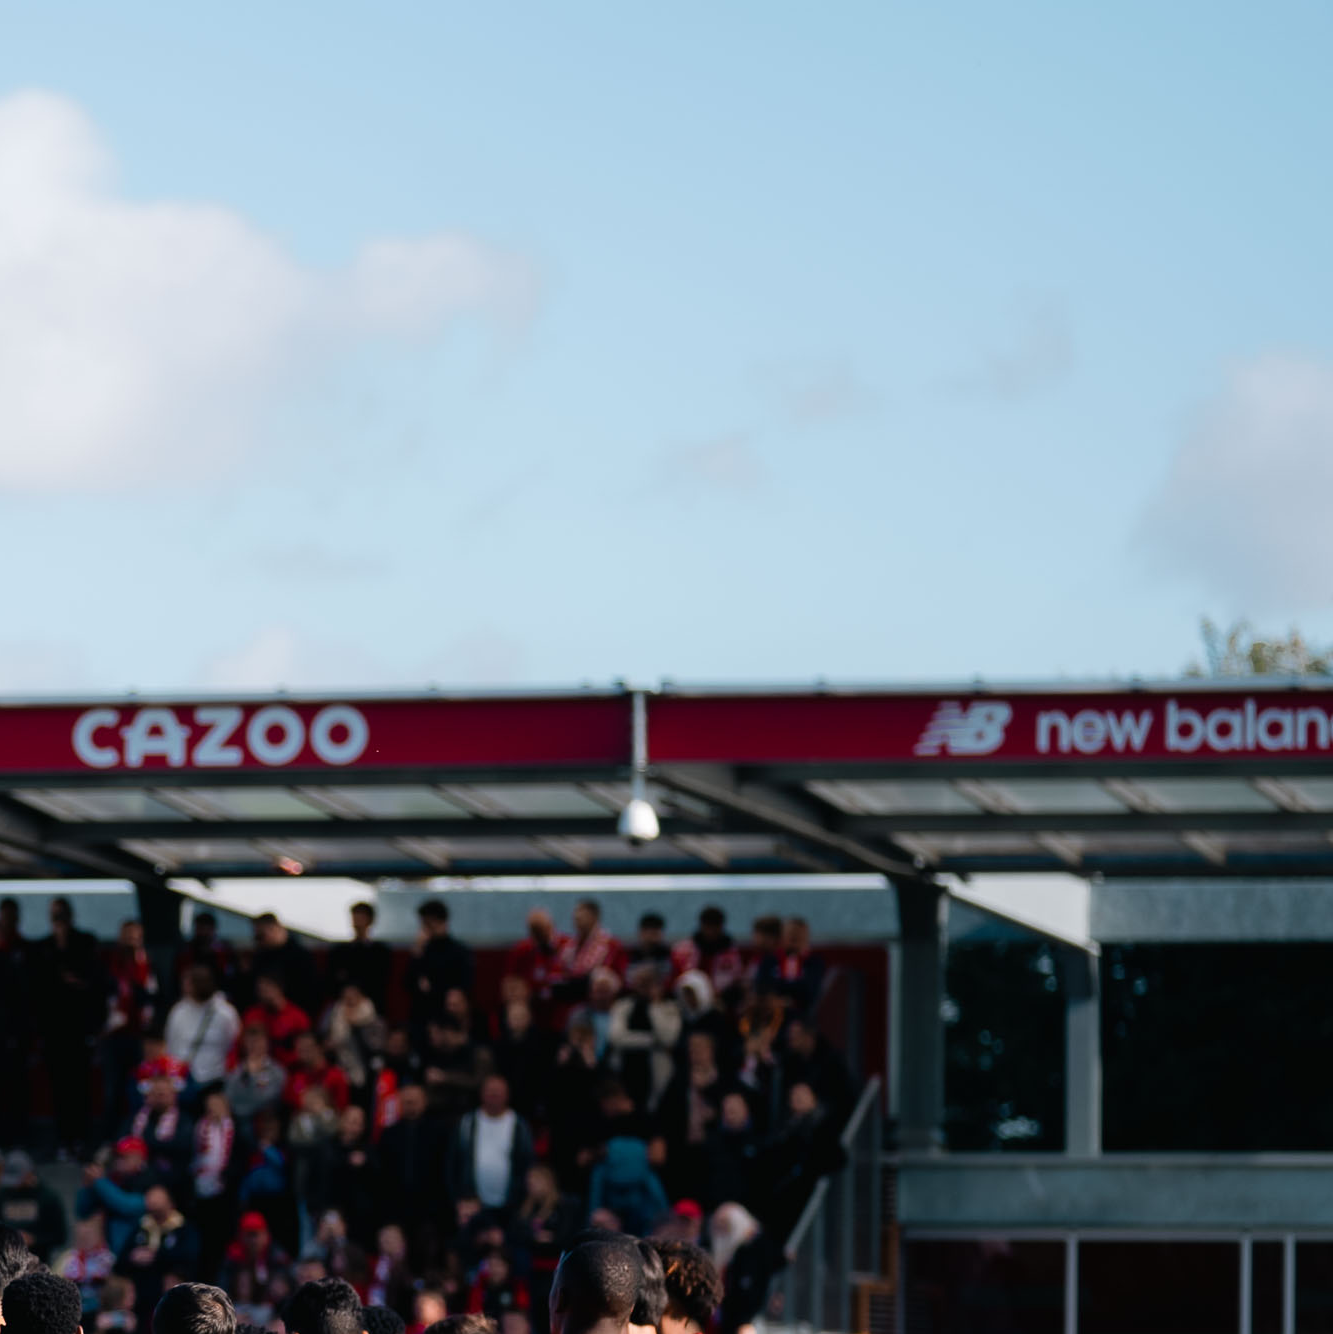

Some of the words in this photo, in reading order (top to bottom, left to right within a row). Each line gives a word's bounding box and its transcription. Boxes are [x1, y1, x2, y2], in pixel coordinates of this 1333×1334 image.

[72, 704, 369, 769] CAZOO
[1035, 709, 1154, 754] new
[1164, 699, 1333, 753] balan
